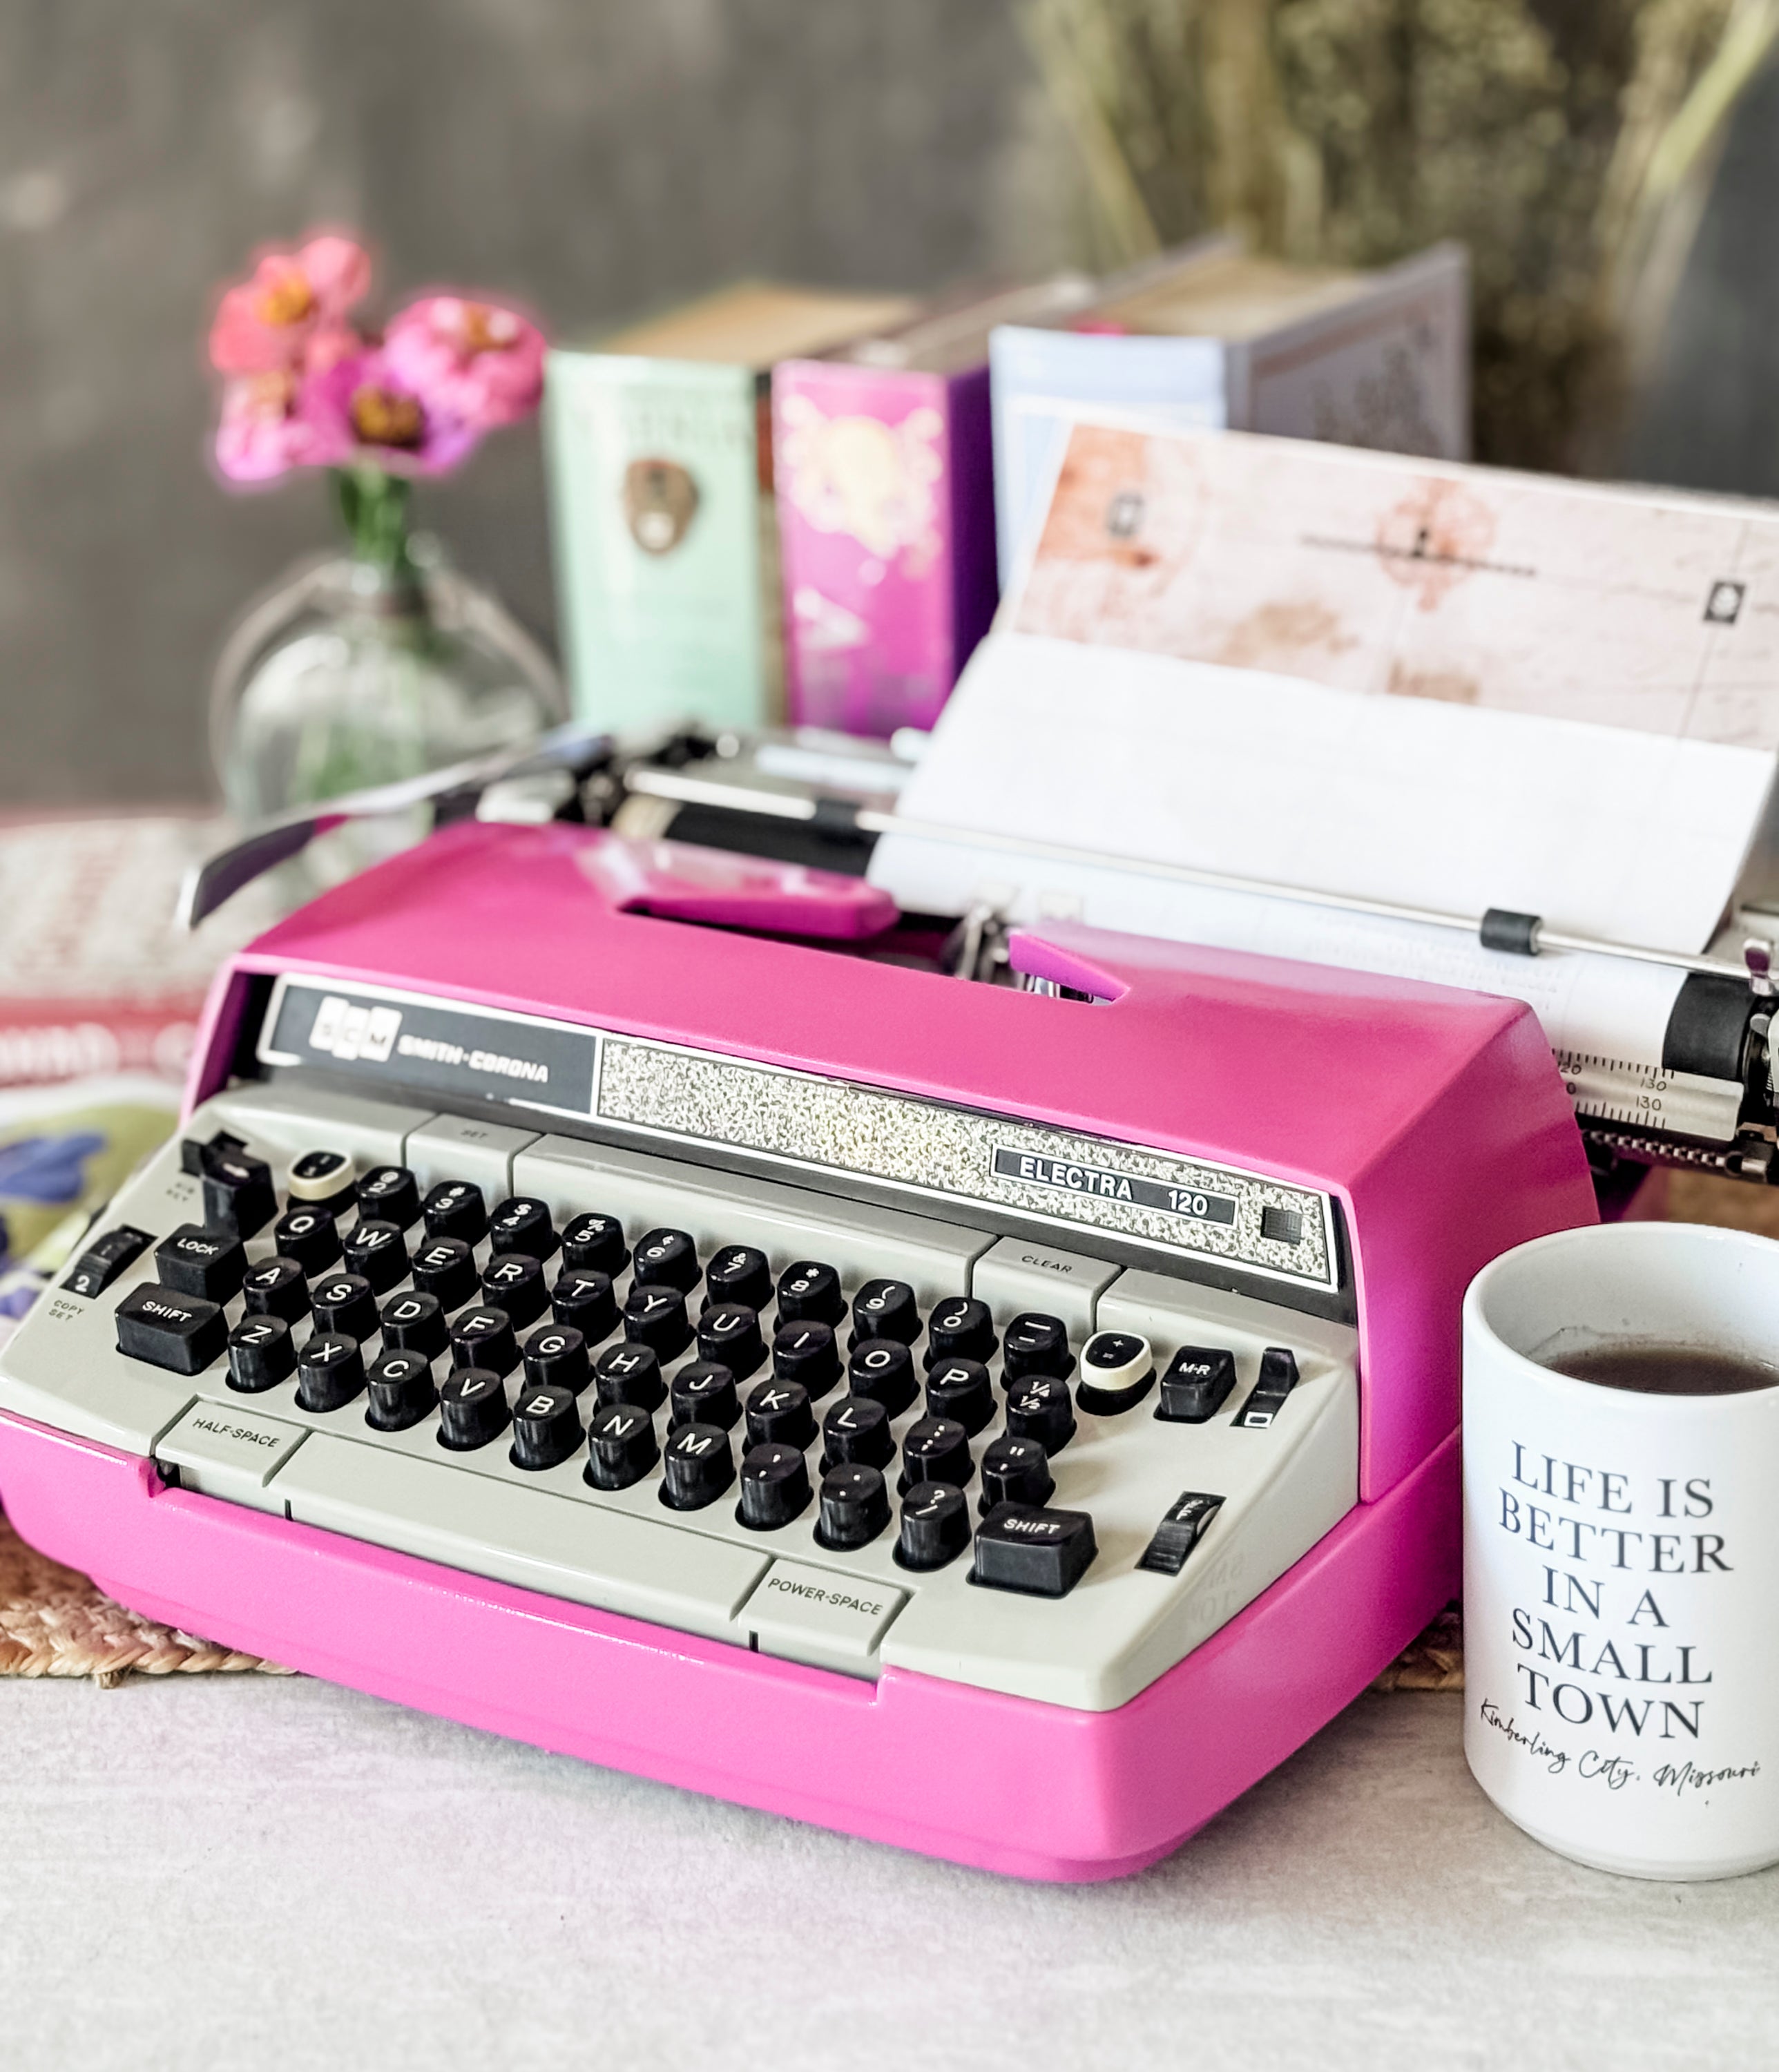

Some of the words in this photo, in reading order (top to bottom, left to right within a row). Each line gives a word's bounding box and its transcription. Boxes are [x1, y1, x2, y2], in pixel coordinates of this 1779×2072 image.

[1641, 1076, 1666, 1091] 130
[1636, 1096, 1662, 1111] 130
[381, 1171, 398, 1183] @
[370, 1182, 386, 1193] 2
[1020, 1156, 1133, 1200] ELECTRA
[1168, 1190, 1208, 1216] 120
[436, 1198, 453, 1209] 3
[515, 1204, 531, 1215] $
[290, 1216, 314, 1233] Q
[503, 1216, 519, 1226] 4
[588, 1218, 606, 1231] %
[356, 1227, 392, 1247] W
[575, 1230, 594, 1241] 5
[177, 1238, 218, 1255] LOCK
[647, 1247, 665, 1257] 6
[425, 1247, 454, 1265] E
[733, 1252, 747, 1265] &
[1021, 1255, 1073, 1274] CLEAR
[256, 1267, 280, 1284] A
[494, 1263, 523, 1281] R
[724, 1262, 742, 1274] 7
[75, 1275, 90, 1292] 2
[572, 1279, 595, 1296] T
[791, 1280, 809, 1292] 8
[327, 1285, 352, 1301] S
[53, 1300, 85, 1315] COPY
[142, 1301, 191, 1321] SHIFT
[394, 1301, 421, 1318] D
[644, 1295, 667, 1312] Y
[866, 1296, 886, 1309] 9
[48, 1309, 73, 1321] SET
[713, 1314, 740, 1331] U
[943, 1316, 961, 1327] 0
[463, 1316, 494, 1332] F
[241, 1325, 272, 1343] Z
[794, 1332, 809, 1347] I
[311, 1343, 342, 1361] X
[539, 1336, 565, 1353] G
[608, 1353, 640, 1372] H
[865, 1351, 890, 1367] O
[383, 1361, 409, 1377] C
[941, 1369, 968, 1384] P
[1179, 1363, 1210, 1375] M-R
[461, 1379, 485, 1396] V
[689, 1375, 713, 1390] J
[526, 1396, 554, 1414] B
[760, 1390, 789, 1409] K
[603, 1415, 633, 1435] N
[838, 1408, 856, 1428] L
[192, 1418, 280, 1448] HALF-SPACE
[677, 1433, 711, 1455] M
[1512, 1439, 1633, 1515] LIFE
[1656, 1478, 1713, 1518] IS
[931, 1490, 945, 1504] ?
[1004, 1519, 1060, 1534] SHIFT
[1499, 1486, 1734, 1573] BETTER
[767, 1577, 883, 1615] POWER-SPACE
[1542, 1565, 1604, 1620] IN
[1626, 1589, 1670, 1627] A
[1512, 1608, 1712, 1684] SMALL
[1517, 1663, 1704, 1739] TOWN
[1480, 1698, 1571, 1774] Kimberling
[1653, 1761, 1760, 1796] Missouri
